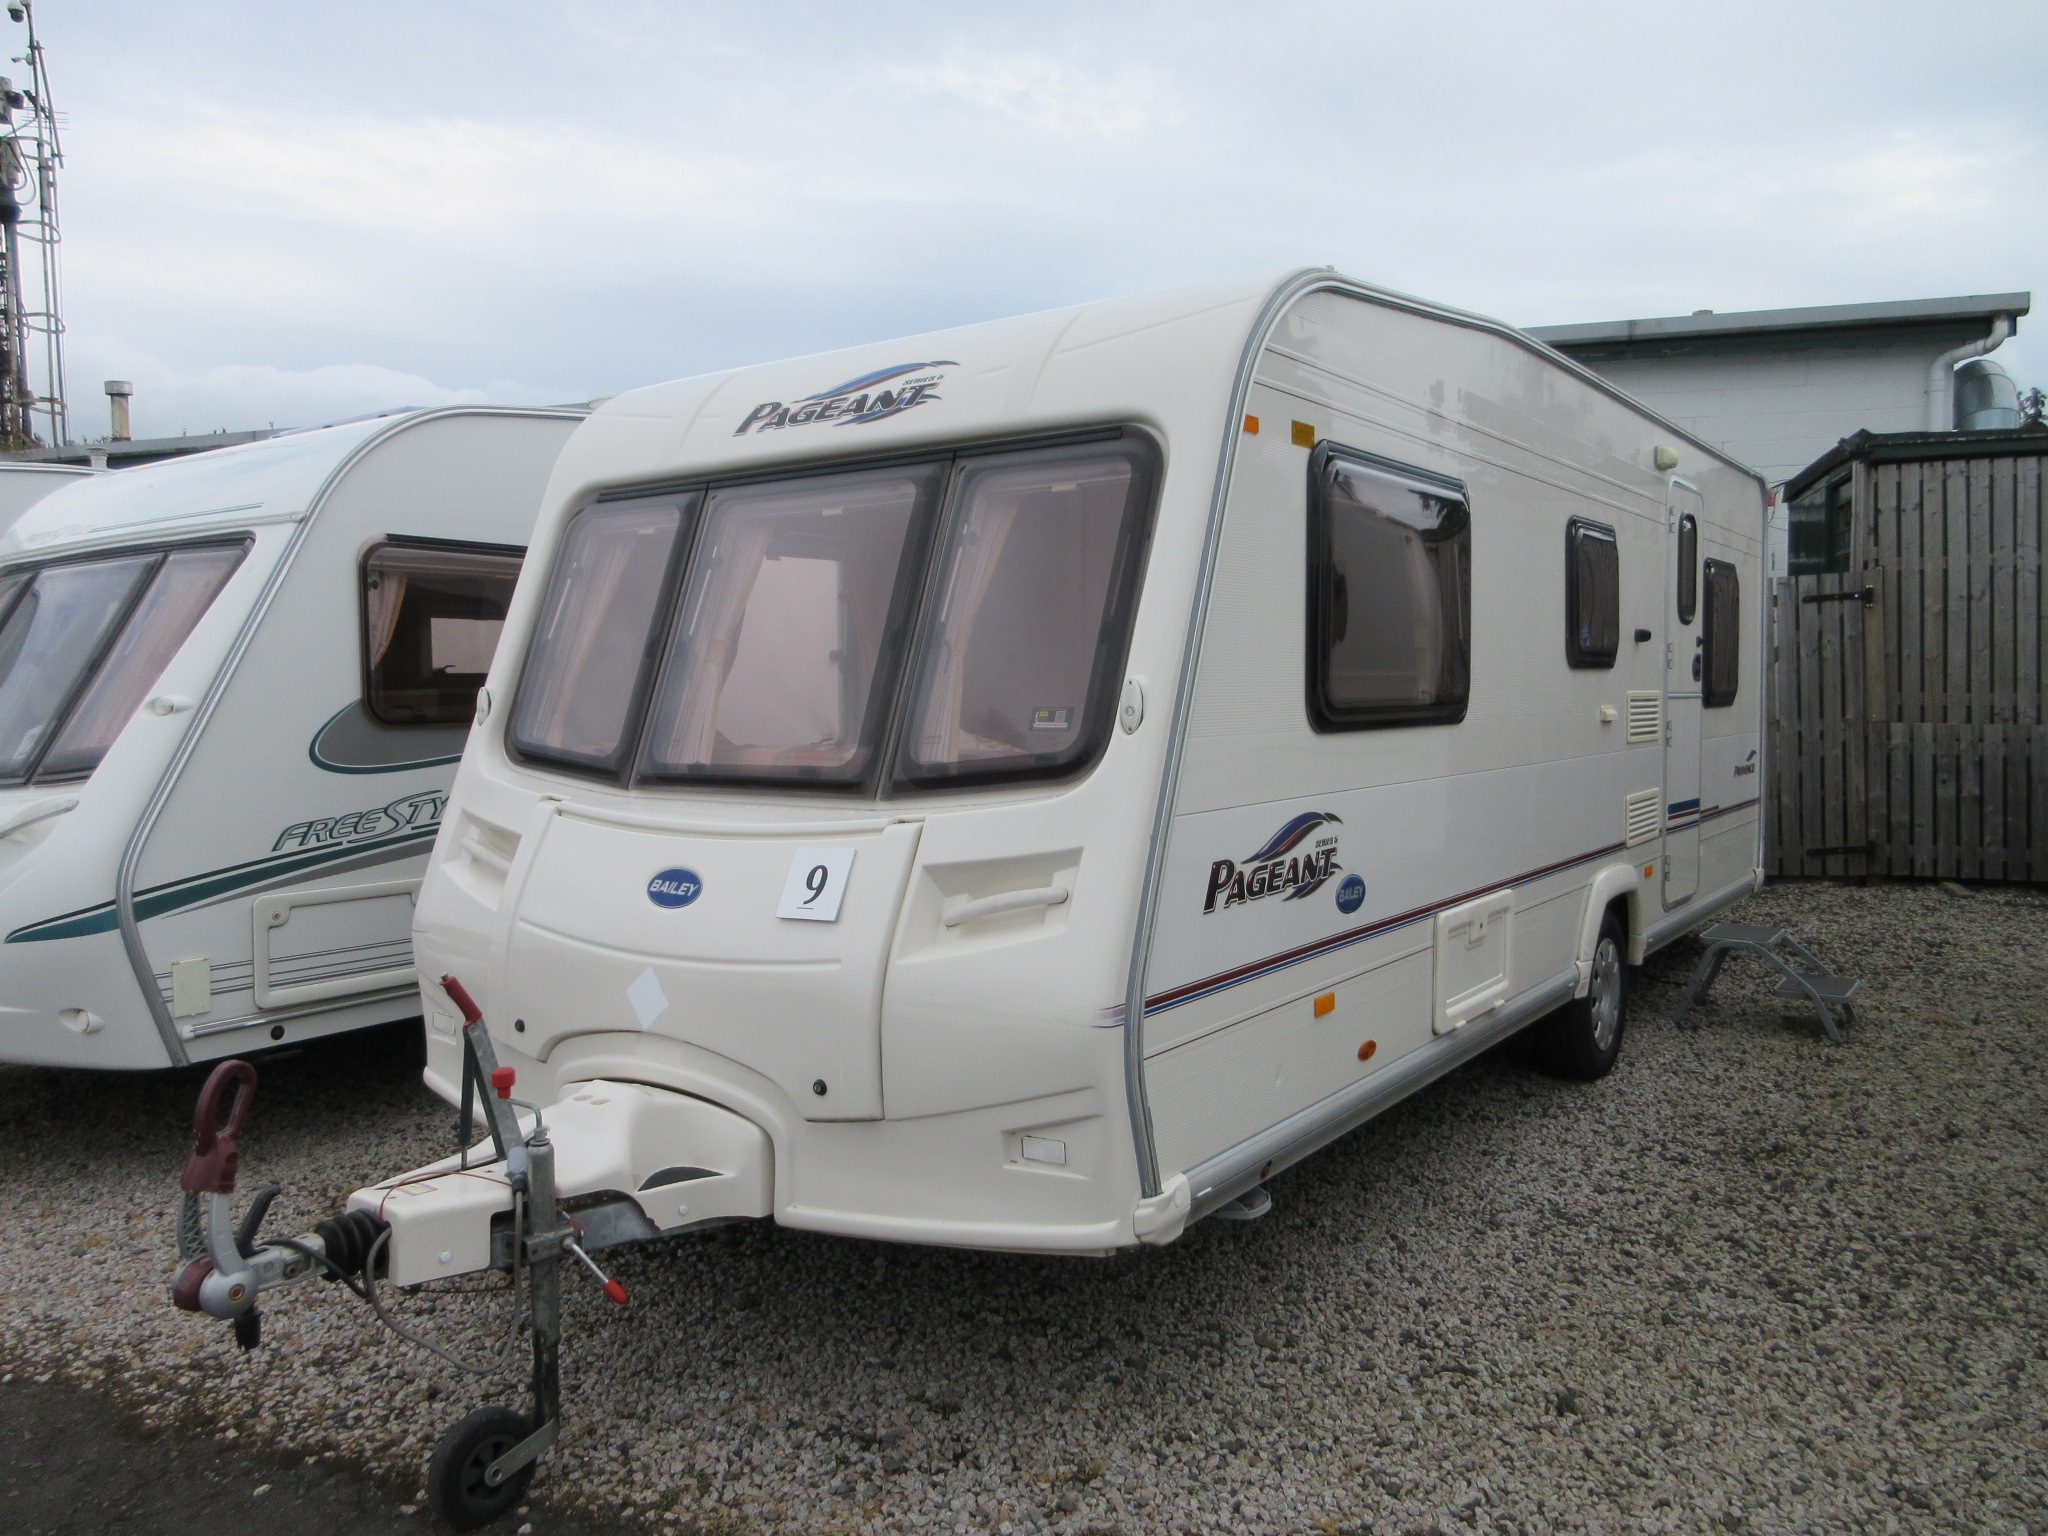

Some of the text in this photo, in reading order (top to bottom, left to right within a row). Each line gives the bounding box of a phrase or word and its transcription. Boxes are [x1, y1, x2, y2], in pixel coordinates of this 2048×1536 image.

[732, 382, 940, 437] PAGEANT
[649, 879, 699, 897] BAILEY
[803, 864, 829, 906] 9
[1203, 847, 1337, 915] PAGEANT
[1338, 884, 1365, 903] BAILEY
